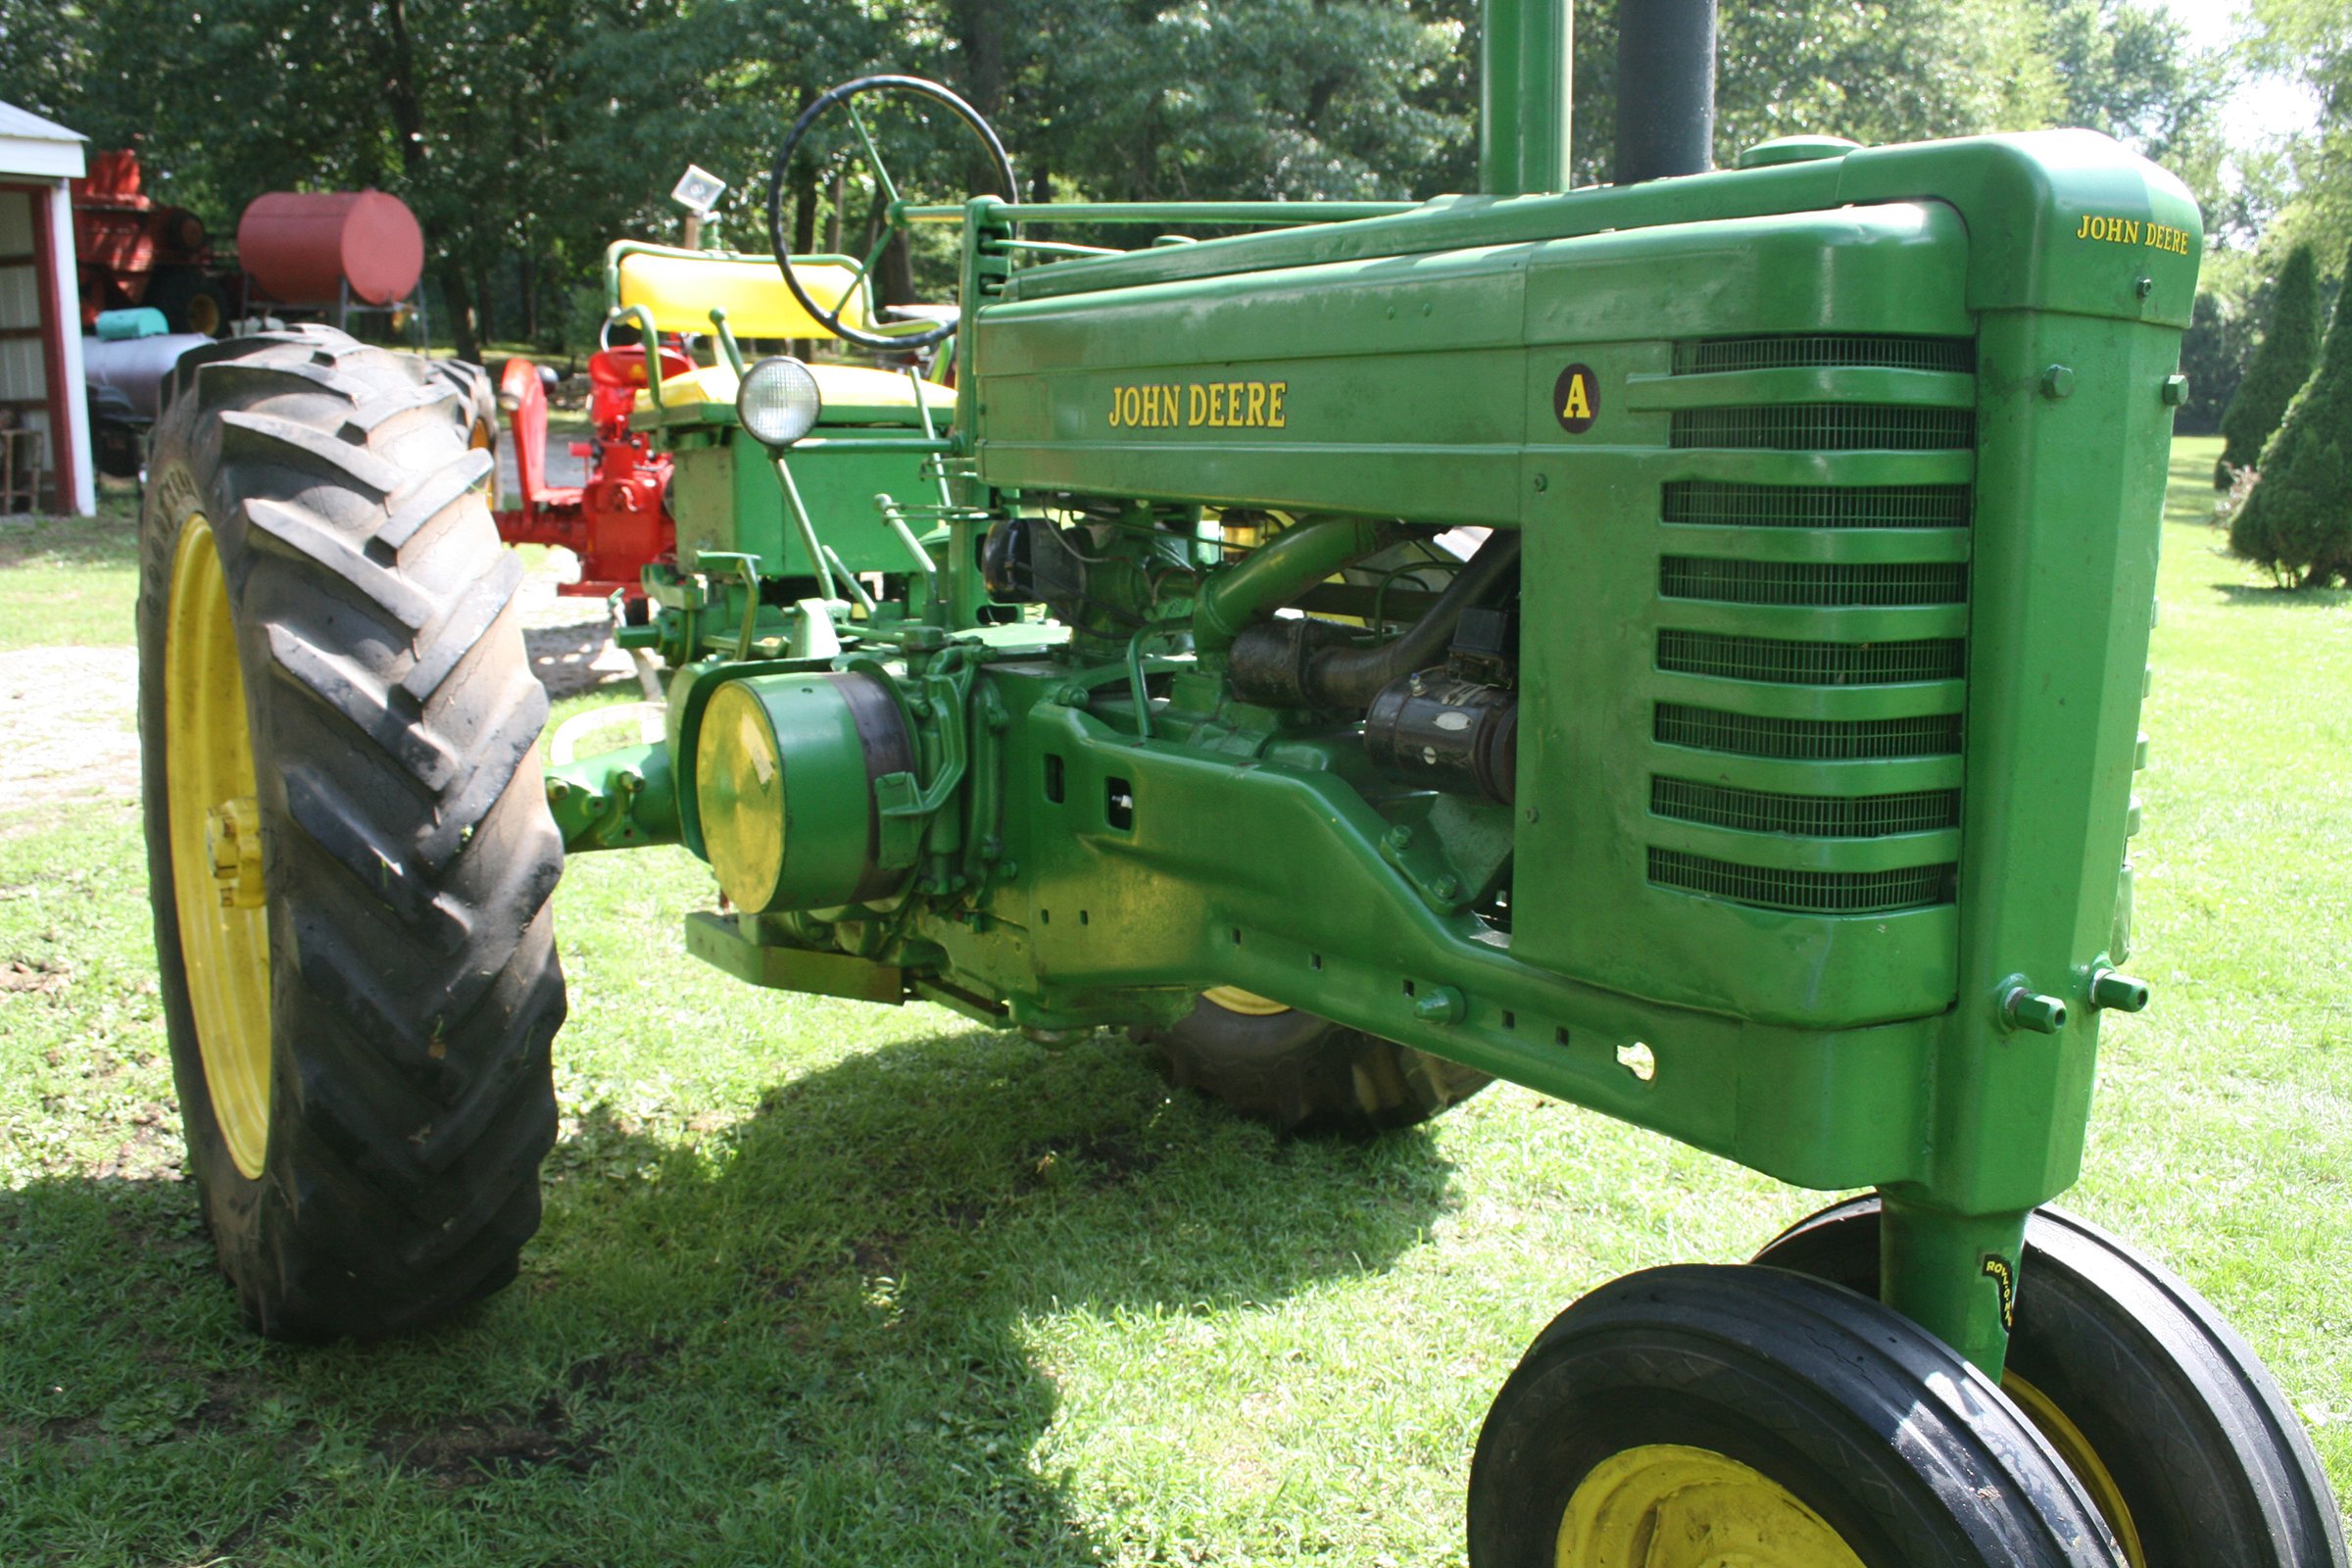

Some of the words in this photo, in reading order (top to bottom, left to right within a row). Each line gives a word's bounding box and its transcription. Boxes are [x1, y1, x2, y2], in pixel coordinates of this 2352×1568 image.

[2077, 215, 2139, 244] JOHN
[2144, 222, 2189, 255] DEERE
[1108, 386, 1180, 427] JOHN
[1188, 381, 1286, 427] DEERE
[1563, 373, 1591, 418] A
